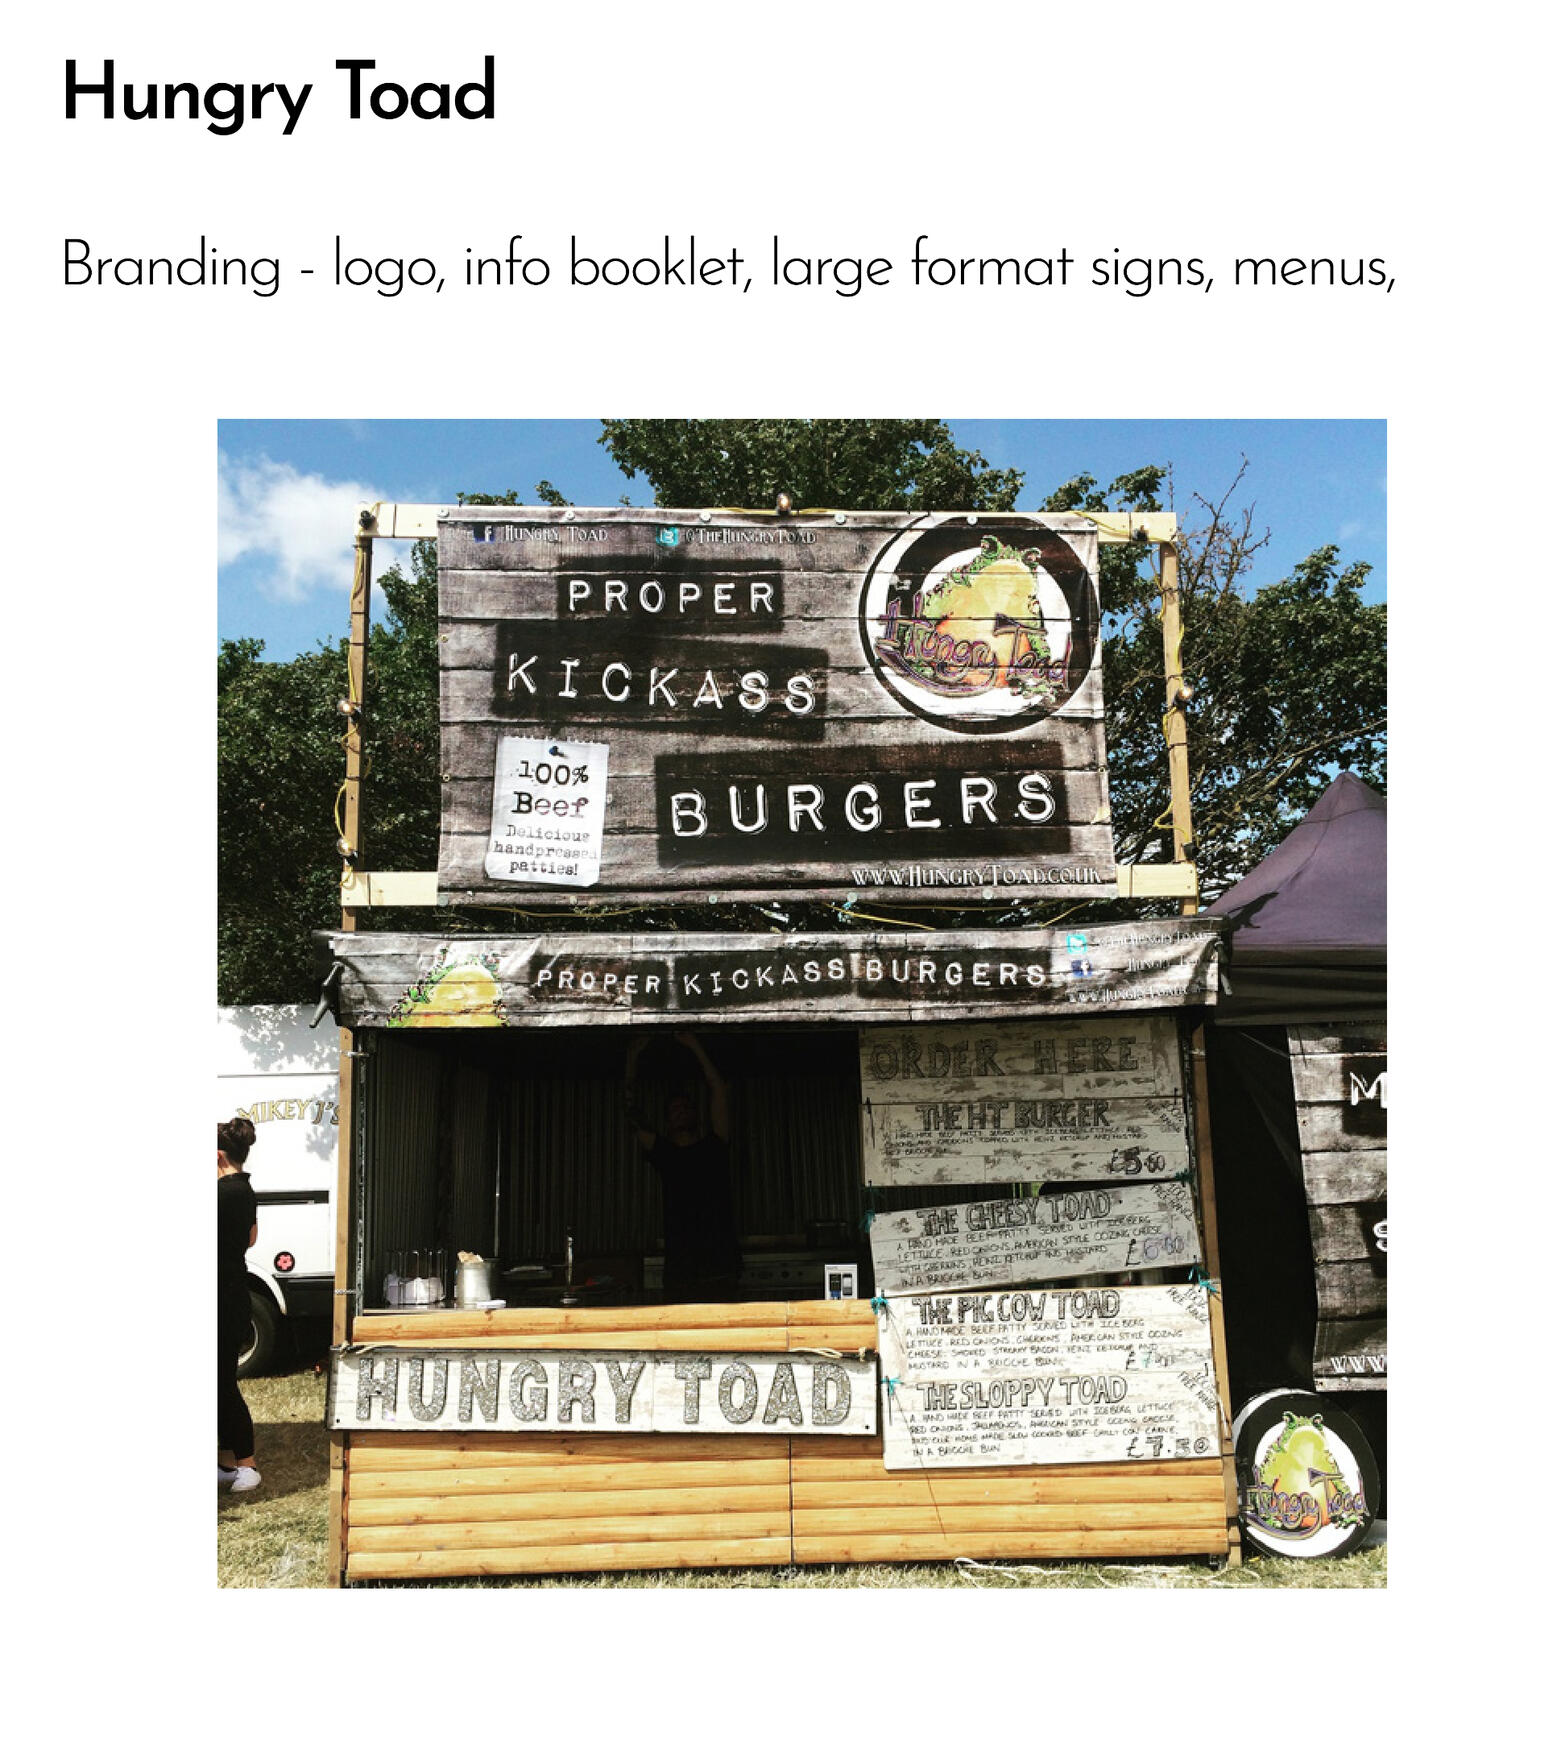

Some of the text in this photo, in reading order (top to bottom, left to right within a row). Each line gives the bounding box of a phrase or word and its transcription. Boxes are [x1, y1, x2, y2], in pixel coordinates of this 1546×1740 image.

[568, 579, 775, 614] PROPER
[507, 652, 816, 715] KICKASS
[515, 759, 590, 786] 100%
[511, 791, 590, 818] Beef
[670, 774, 1056, 838] BURGERS
[505, 824, 590, 842] Delicious
[509, 859, 579, 877] patties!
[537, 953, 1047, 996] PROPER KICKASS BURGERS
[871, 1036, 1140, 1080] ORDER HERE
[237, 1098, 311, 1124] MIKEY
[916, 1103, 962, 1131] THE
[1014, 1100, 1112, 1130] BURGER
[917, 1207, 959, 1237] THE
[966, 1199, 1039, 1232] CHEESY
[1044, 1190, 1111, 1223] TOAD
[912, 1289, 1121, 1324] THE PIG COW TOAD
[355, 1356, 852, 1427] HUNGRY TOAD
[916, 1375, 1128, 1411] THE SLOPPY TOAD
